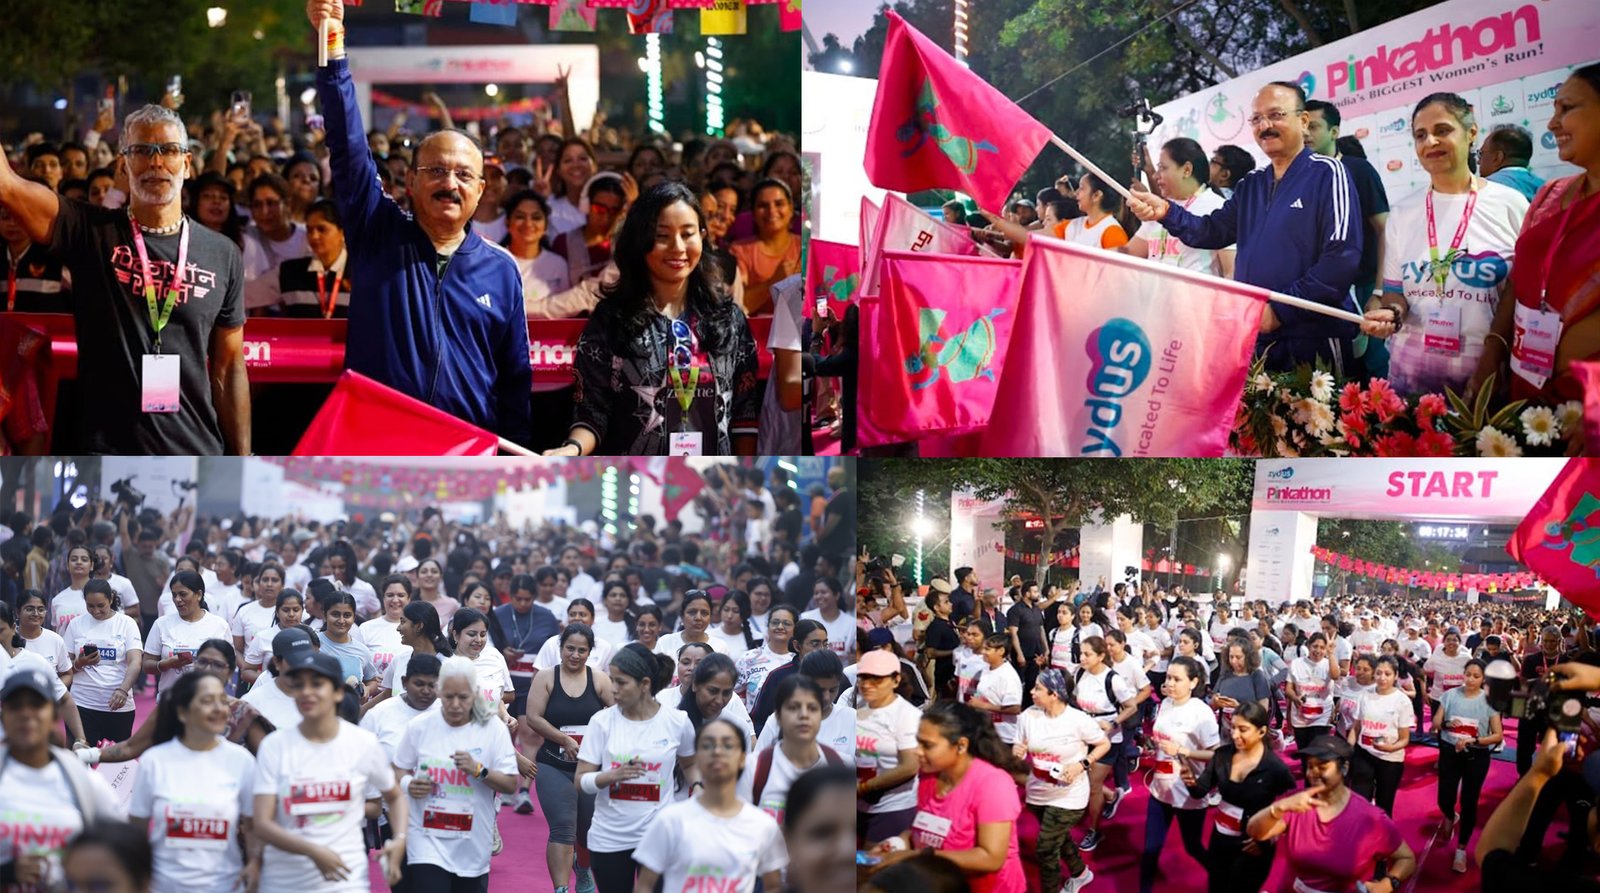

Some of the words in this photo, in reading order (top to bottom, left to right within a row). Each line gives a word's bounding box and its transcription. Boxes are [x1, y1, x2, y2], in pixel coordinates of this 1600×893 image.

[1327, 4, 1541, 98] Pinkathon
[1369, 76, 1424, 99] BIGGEST
[1429, 57, 1498, 82] Women's
[1504, 43, 1545, 64] Run!
[1528, 87, 1557, 102] zydu
[1401, 260, 1497, 284] zyus
[1458, 290, 1472, 301] To
[1159, 339, 1183, 374] Life
[1151, 376, 1170, 396] To
[1267, 486, 1331, 500] Pinkathon
[1386, 471, 1498, 497] START
